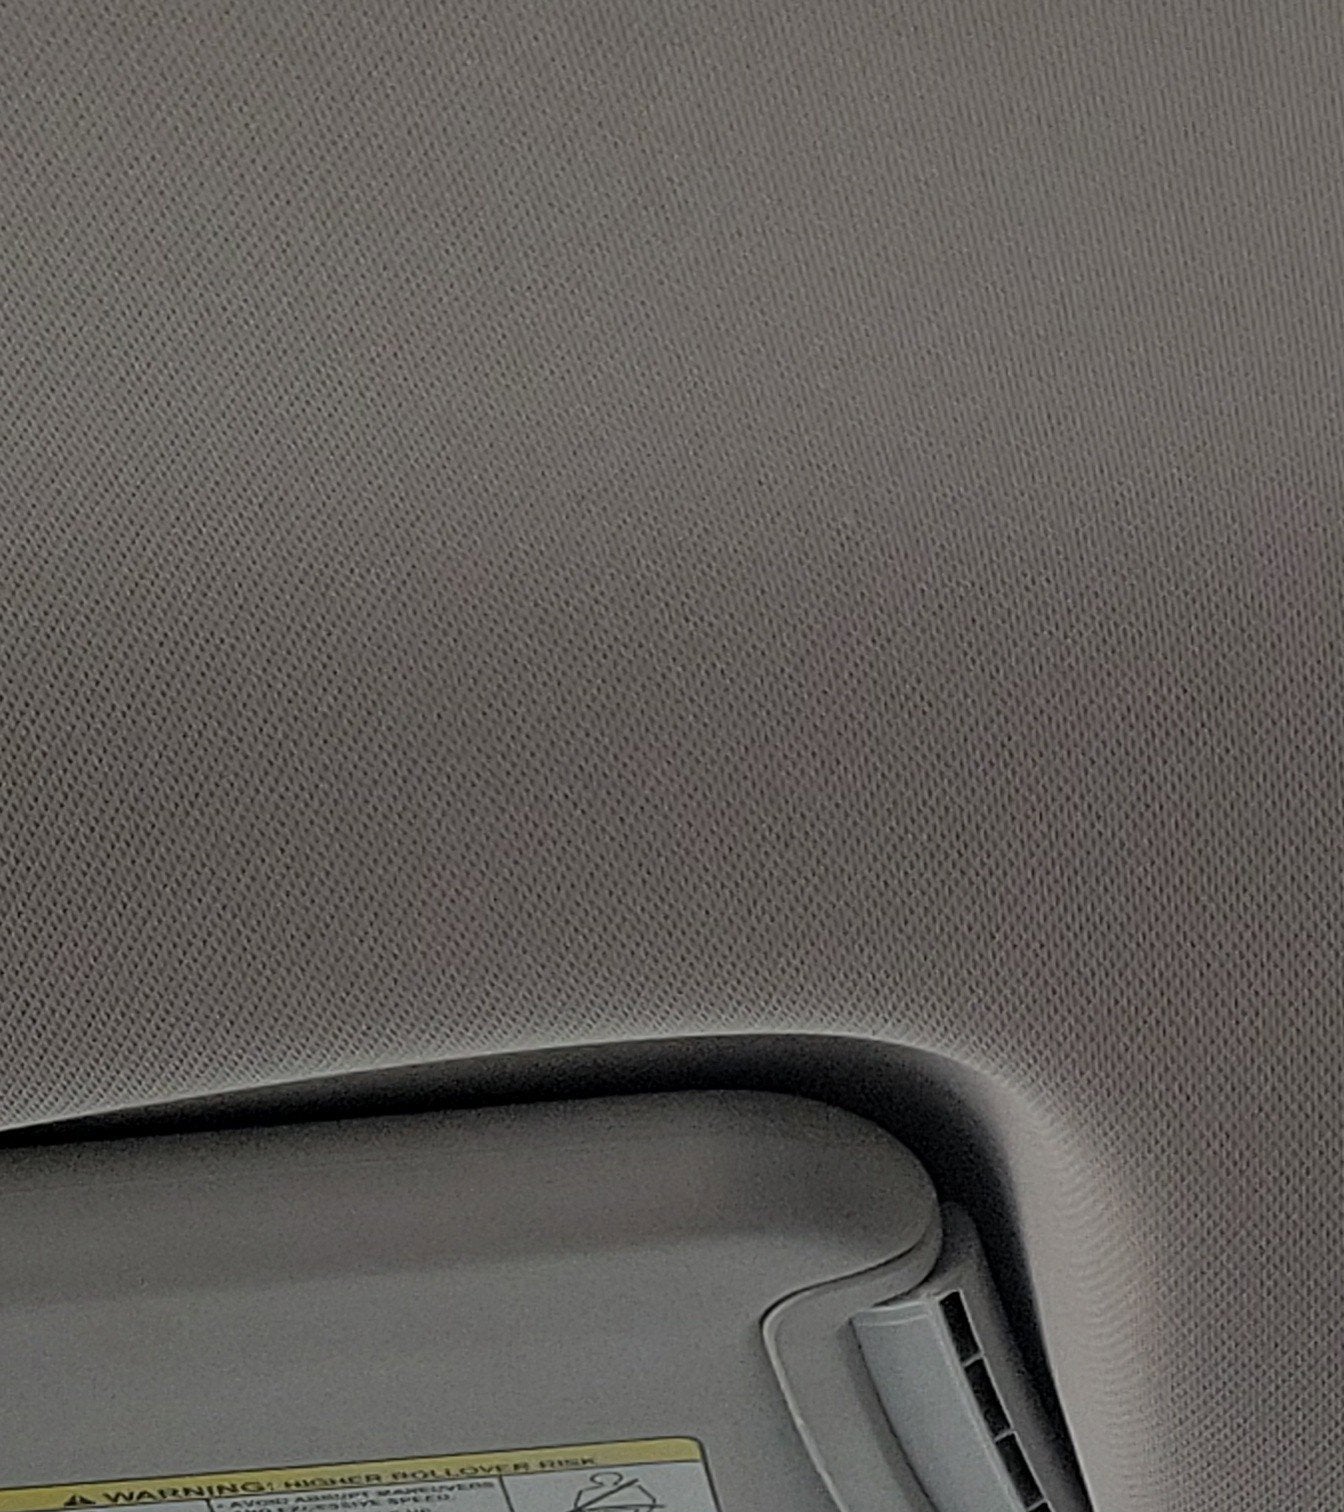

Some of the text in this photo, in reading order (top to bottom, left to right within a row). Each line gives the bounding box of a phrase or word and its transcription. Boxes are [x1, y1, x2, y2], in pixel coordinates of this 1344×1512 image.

[282, 1457, 596, 1488] HIGHER ROLLOVER RISK
